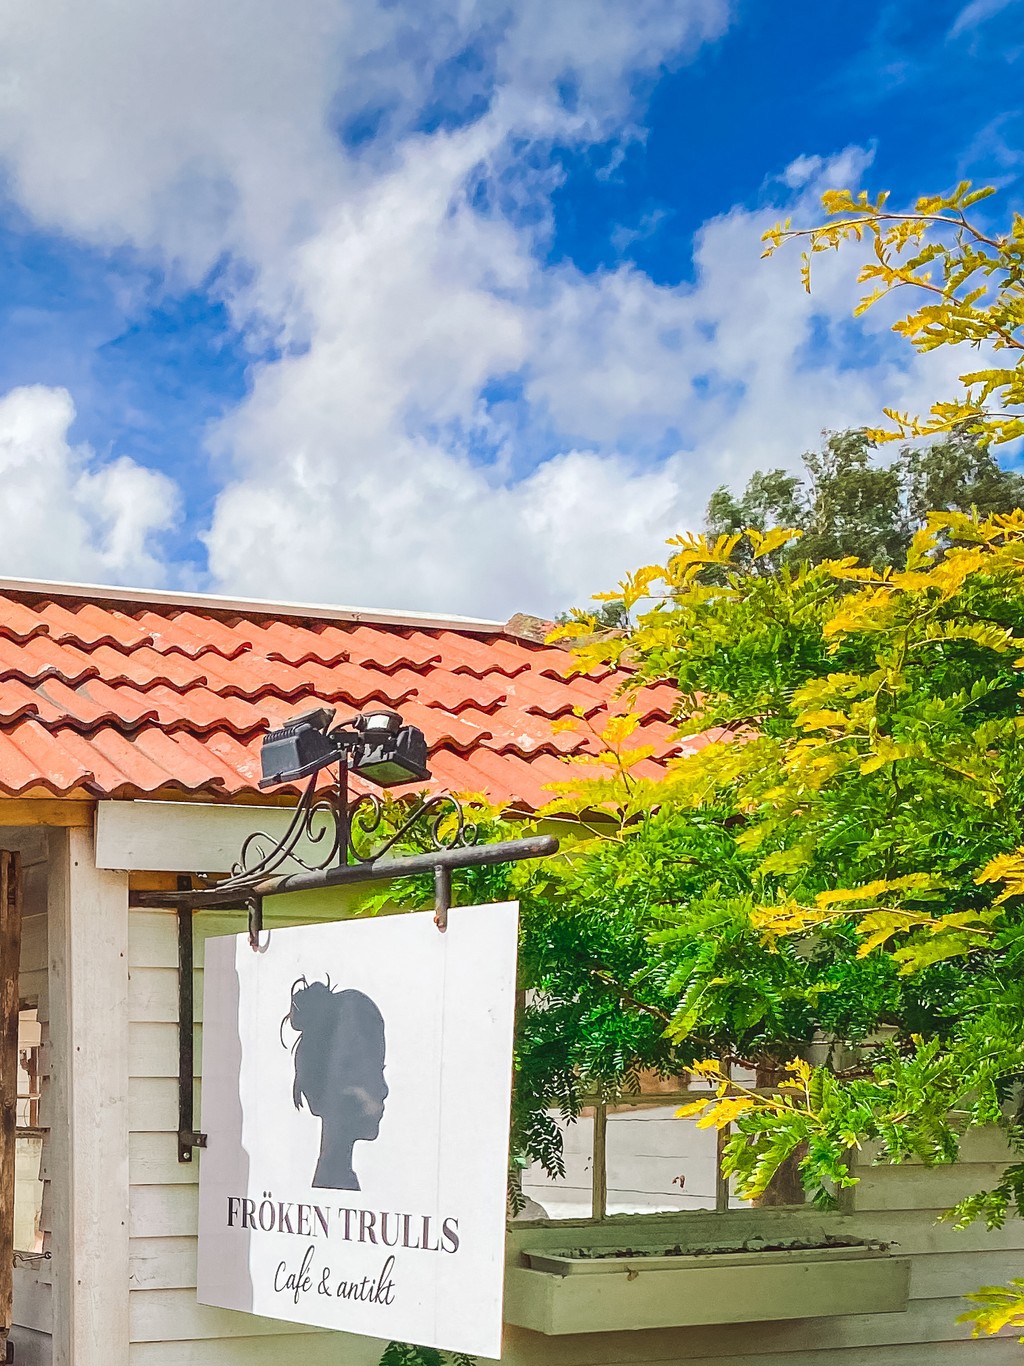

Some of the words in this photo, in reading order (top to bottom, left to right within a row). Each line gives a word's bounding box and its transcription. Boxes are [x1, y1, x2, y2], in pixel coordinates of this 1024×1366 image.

[227, 1191, 331, 1239] FRÖKEN
[339, 1206, 460, 1254] TRULLS
[274, 1245, 315, 1305] Café
[317, 1267, 332, 1297] &
[336, 1255, 396, 1305] antikt
